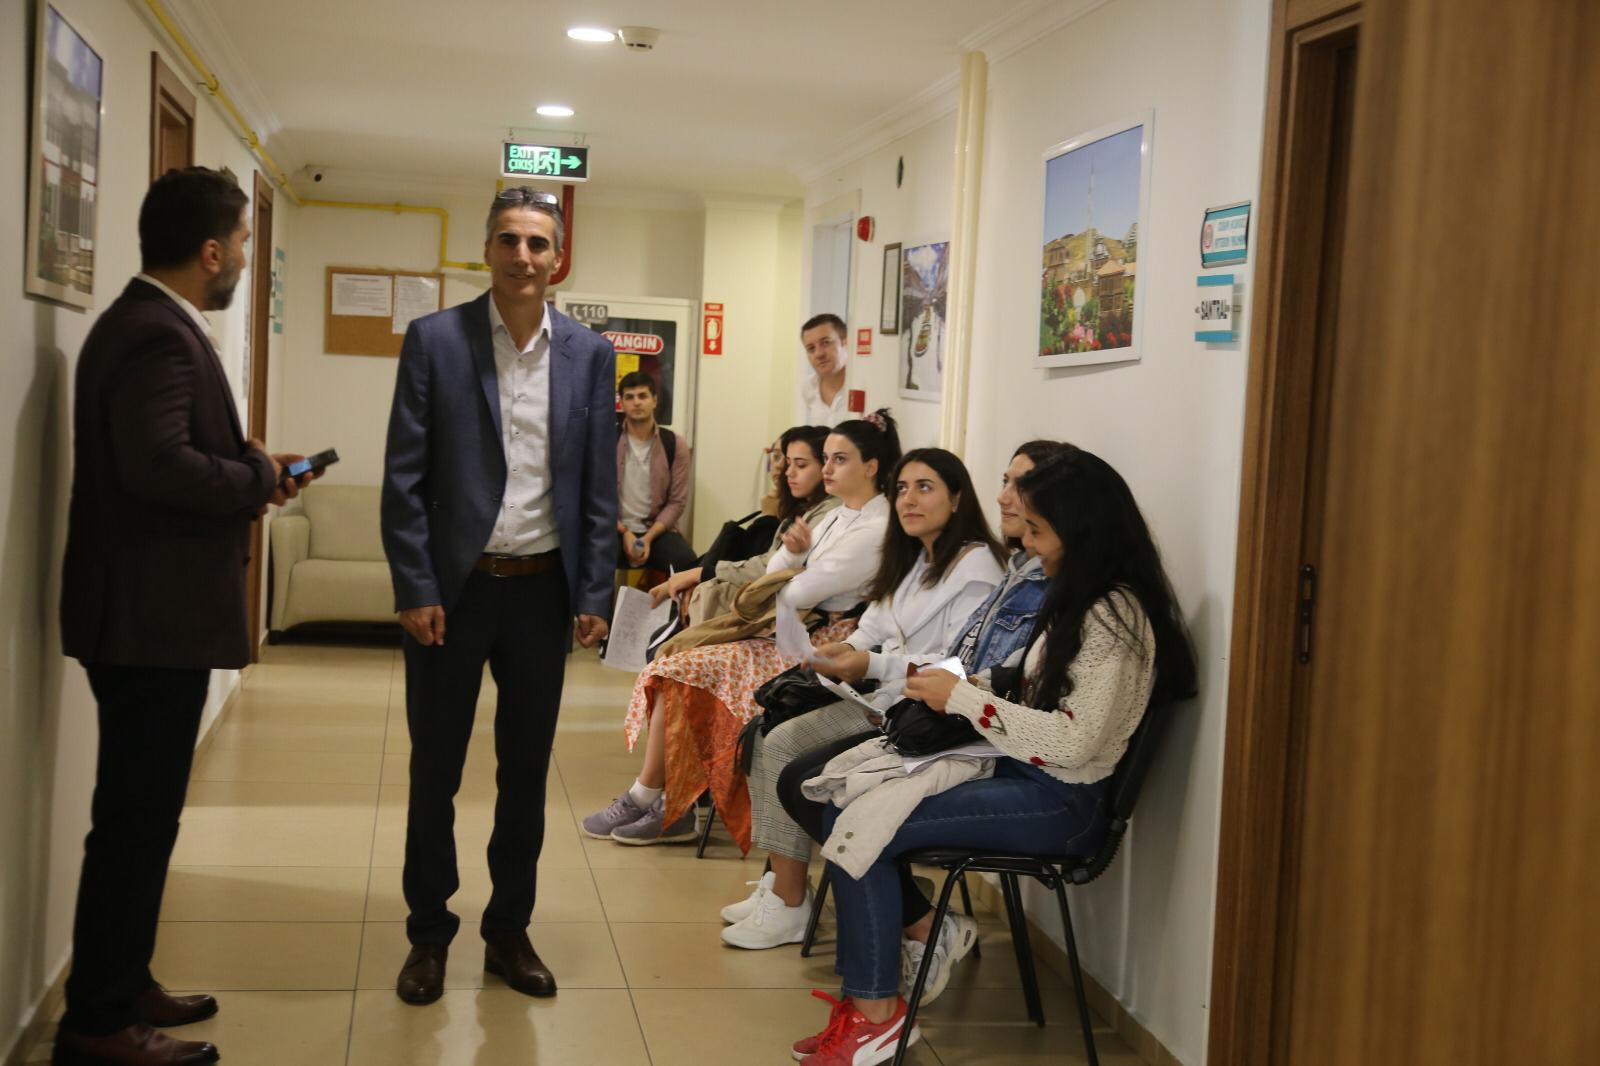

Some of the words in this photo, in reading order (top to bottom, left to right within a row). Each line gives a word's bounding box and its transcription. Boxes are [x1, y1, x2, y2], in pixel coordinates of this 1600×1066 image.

[509, 145, 533, 159] EXIT
[582, 305, 606, 319] 110
[606, 333, 657, 350] YANGIN
